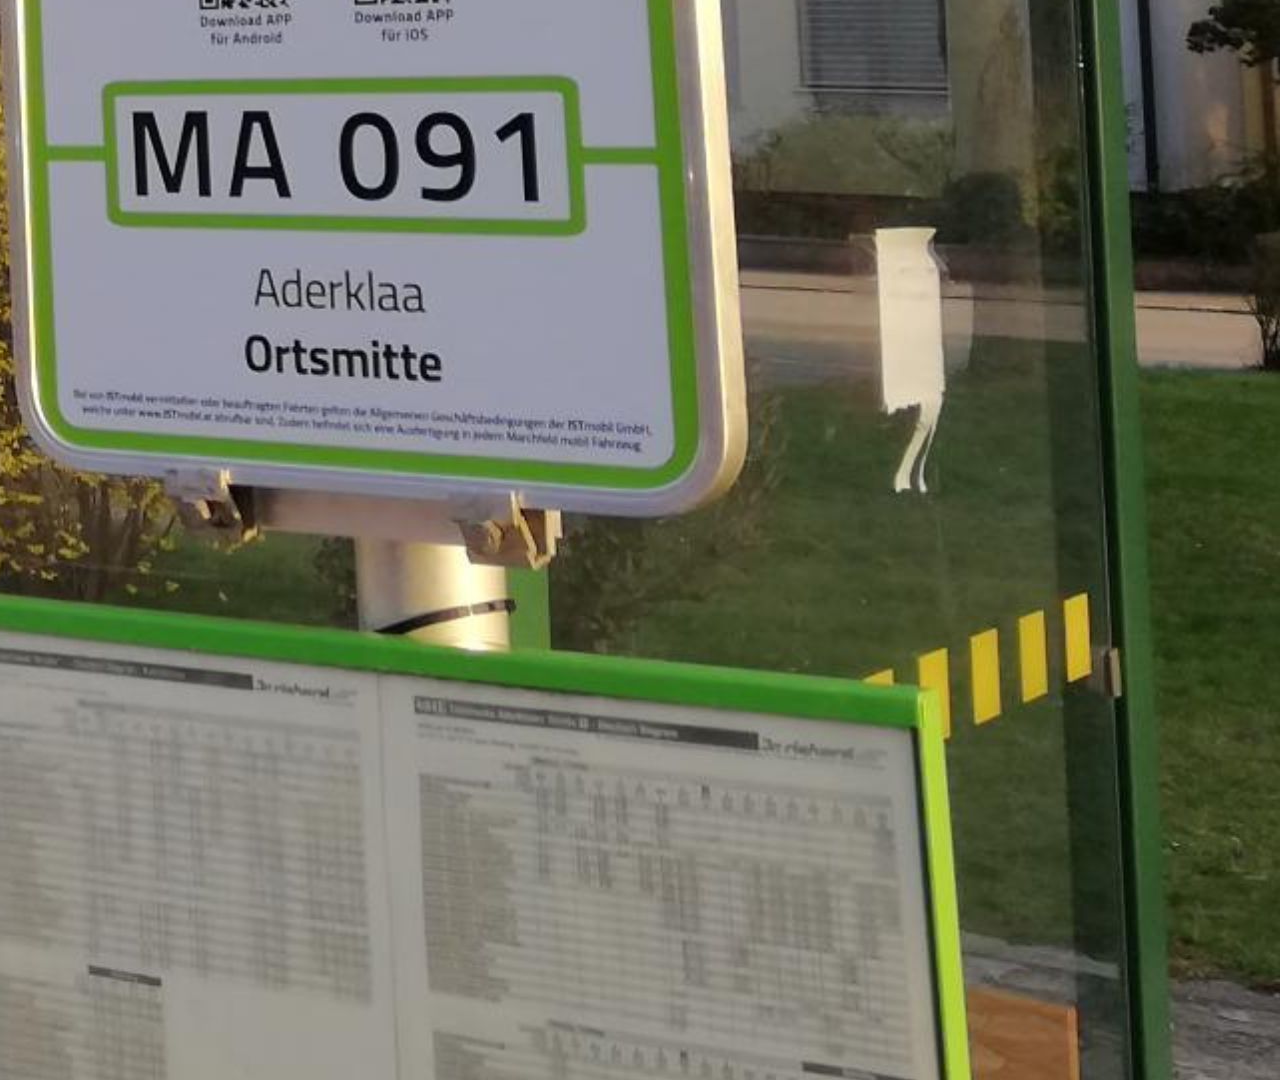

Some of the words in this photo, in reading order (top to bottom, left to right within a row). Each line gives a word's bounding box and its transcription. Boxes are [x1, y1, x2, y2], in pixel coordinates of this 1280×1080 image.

[199, 14, 263, 28] Download
[266, 13, 292, 26] APP
[354, 10, 422, 25] Download
[426, 8, 454, 21] APP
[210, 32, 229, 45] für
[232, 31, 283, 45] Android
[381, 29, 401, 42] für
[131, 110, 292, 198] MA
[338, 111, 540, 202] 091
[254, 268, 426, 314] Aderklaa
[244, 334, 443, 382] Ortsmitte
